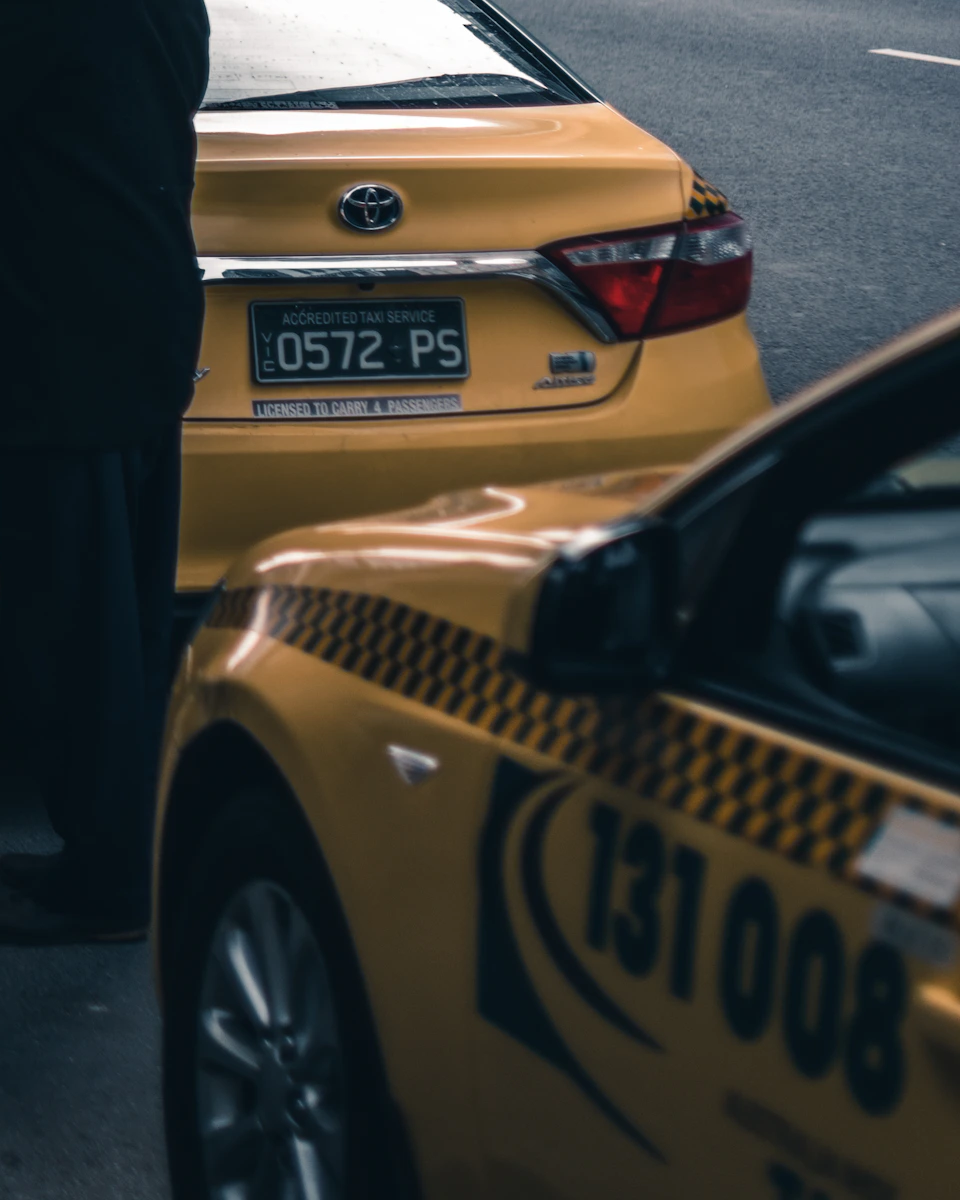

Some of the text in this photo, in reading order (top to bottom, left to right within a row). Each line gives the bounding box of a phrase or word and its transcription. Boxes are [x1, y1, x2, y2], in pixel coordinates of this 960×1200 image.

[282, 310, 436, 325] ACCREDITED TAXI SERVICE
[261, 332, 275, 372] VIC
[277, 328, 462, 371] 0572 PS
[256, 397, 459, 417] LICENSED TO CARRY 4 PASSENGERS
[586, 798, 908, 1117] 131 008
